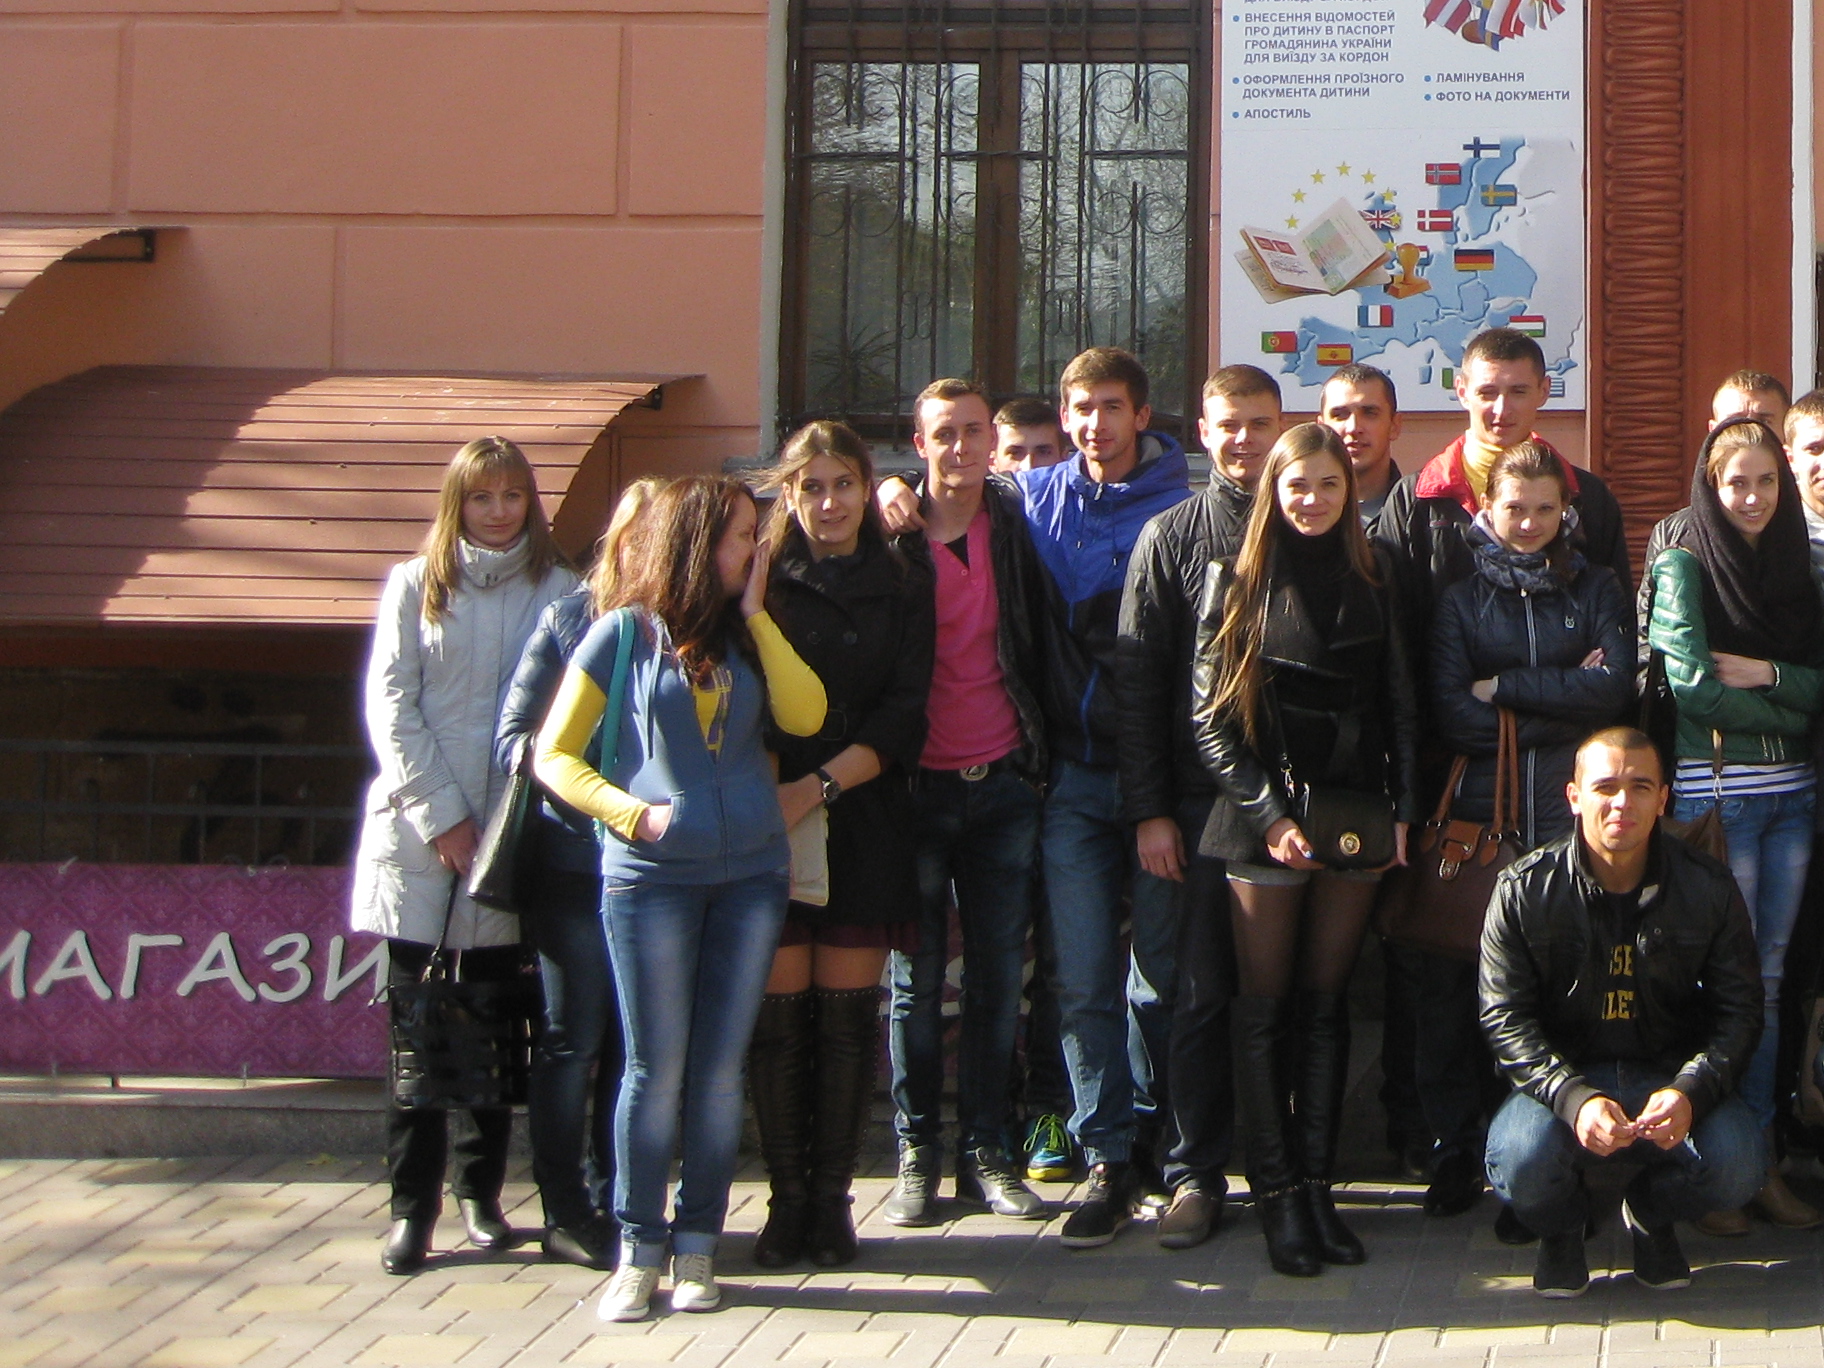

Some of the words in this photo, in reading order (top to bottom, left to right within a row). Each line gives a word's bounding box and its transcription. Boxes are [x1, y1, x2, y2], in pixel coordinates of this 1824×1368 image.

[1246, 12, 1312, 23] ВНЕСЕННЯ
[1316, 11, 1395, 23] ВІДОМОСТЕЙ
[1244, 26, 1269, 36] ПРО
[1272, 25, 1322, 37] ДИТИНУ
[1326, 25, 1333, 35] В
[1337, 24, 1395, 35] ПАСПОРТ
[1245, 40, 1338, 51] ГРОМАДЯНИНА
[1342, 37, 1391, 49] УКРАЇНИ
[1244, 53, 1271, 64] ДЛЯ
[1274, 51, 1318, 63] ВИЇЗДУ
[1320, 53, 1336, 63] ЗА
[1340, 53, 1389, 63] КОРДОН
[1243, 74, 1331, 86] ОФОРМЛЕННЯ
[1335, 72, 1404, 84] ПРОЇЗНОГО
[1436, 72, 1524, 83] ЛАМІНУВАННЯ
[1242, 88, 1317, 100] ДОКУМЕНТА
[1321, 88, 1370, 99] ДИТИНИ
[1436, 91, 1471, 102] ФОТО
[1475, 91, 1492, 101] НА
[1495, 90, 1570, 102] ДОКУМЕНТИ
[1244, 109, 1311, 120] АПОСТИЛЬ
